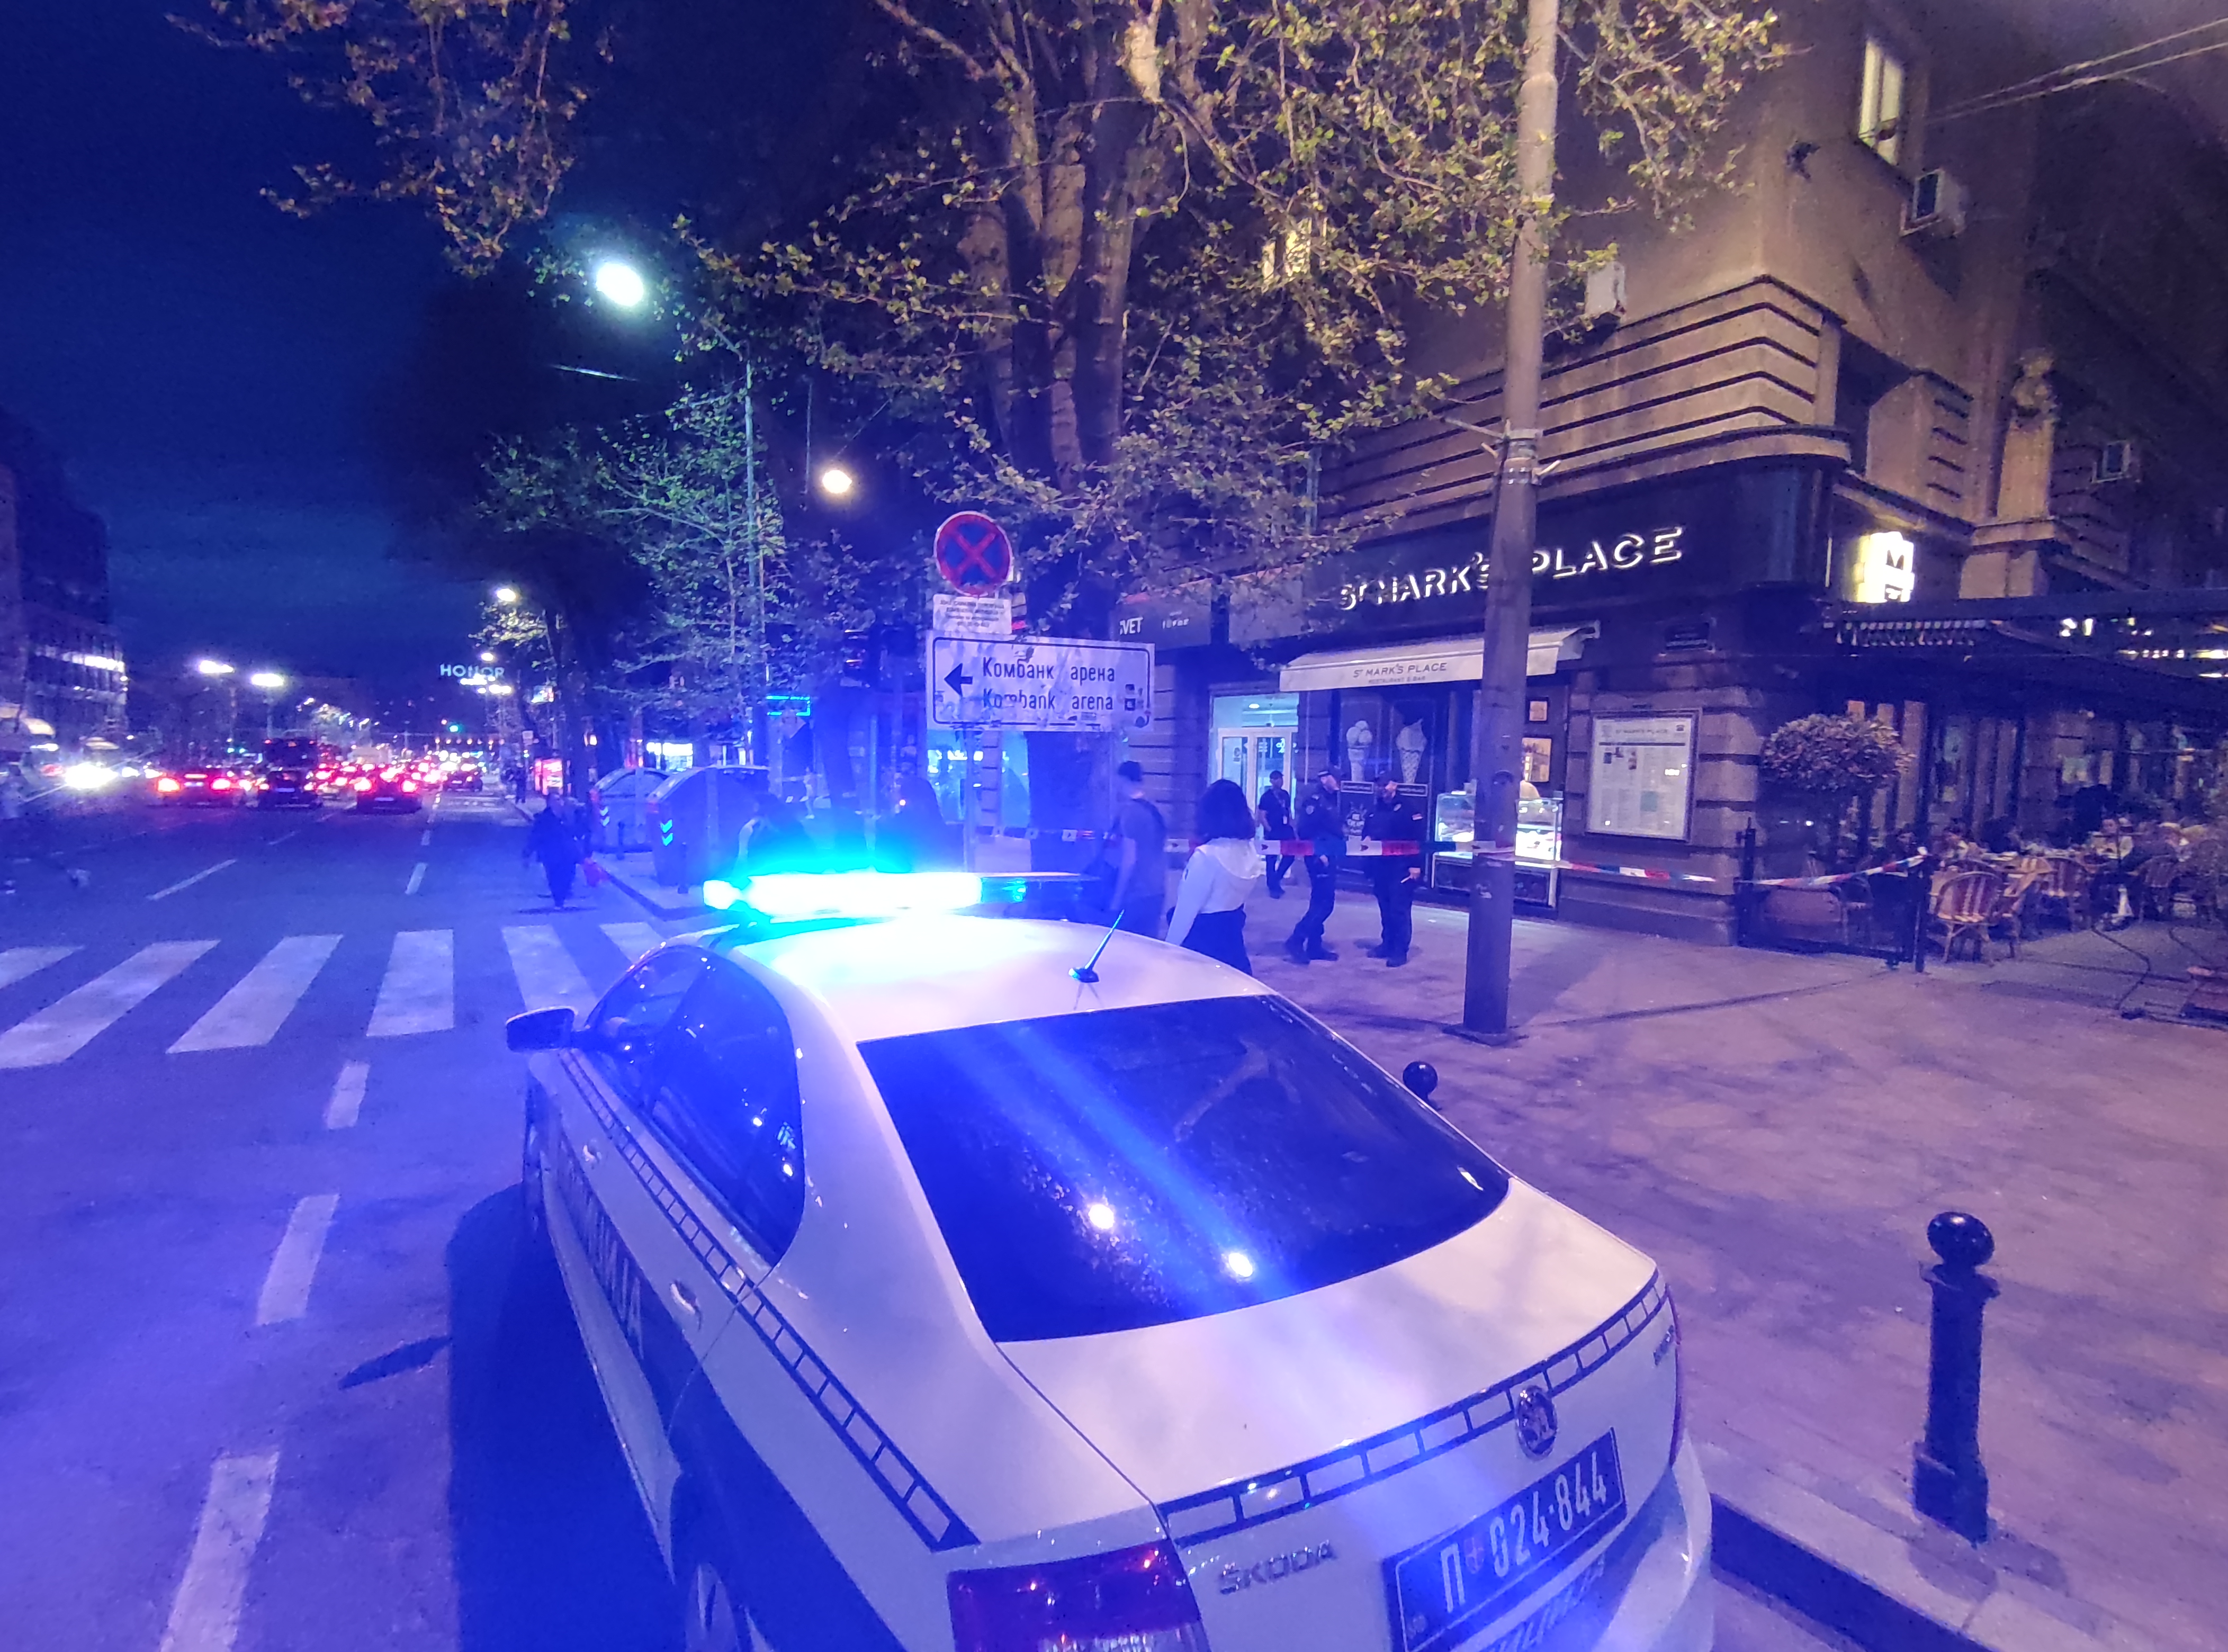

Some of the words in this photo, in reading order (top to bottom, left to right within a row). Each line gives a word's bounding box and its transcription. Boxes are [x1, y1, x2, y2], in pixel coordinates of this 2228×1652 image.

[982, 657, 1055, 679] Комбанк
[1070, 666, 1116, 687] арена
[1365, 663, 1405, 676] MARK'S
[1407, 662, 1448, 674] PLACE
[1071, 695, 1113, 711] arena
